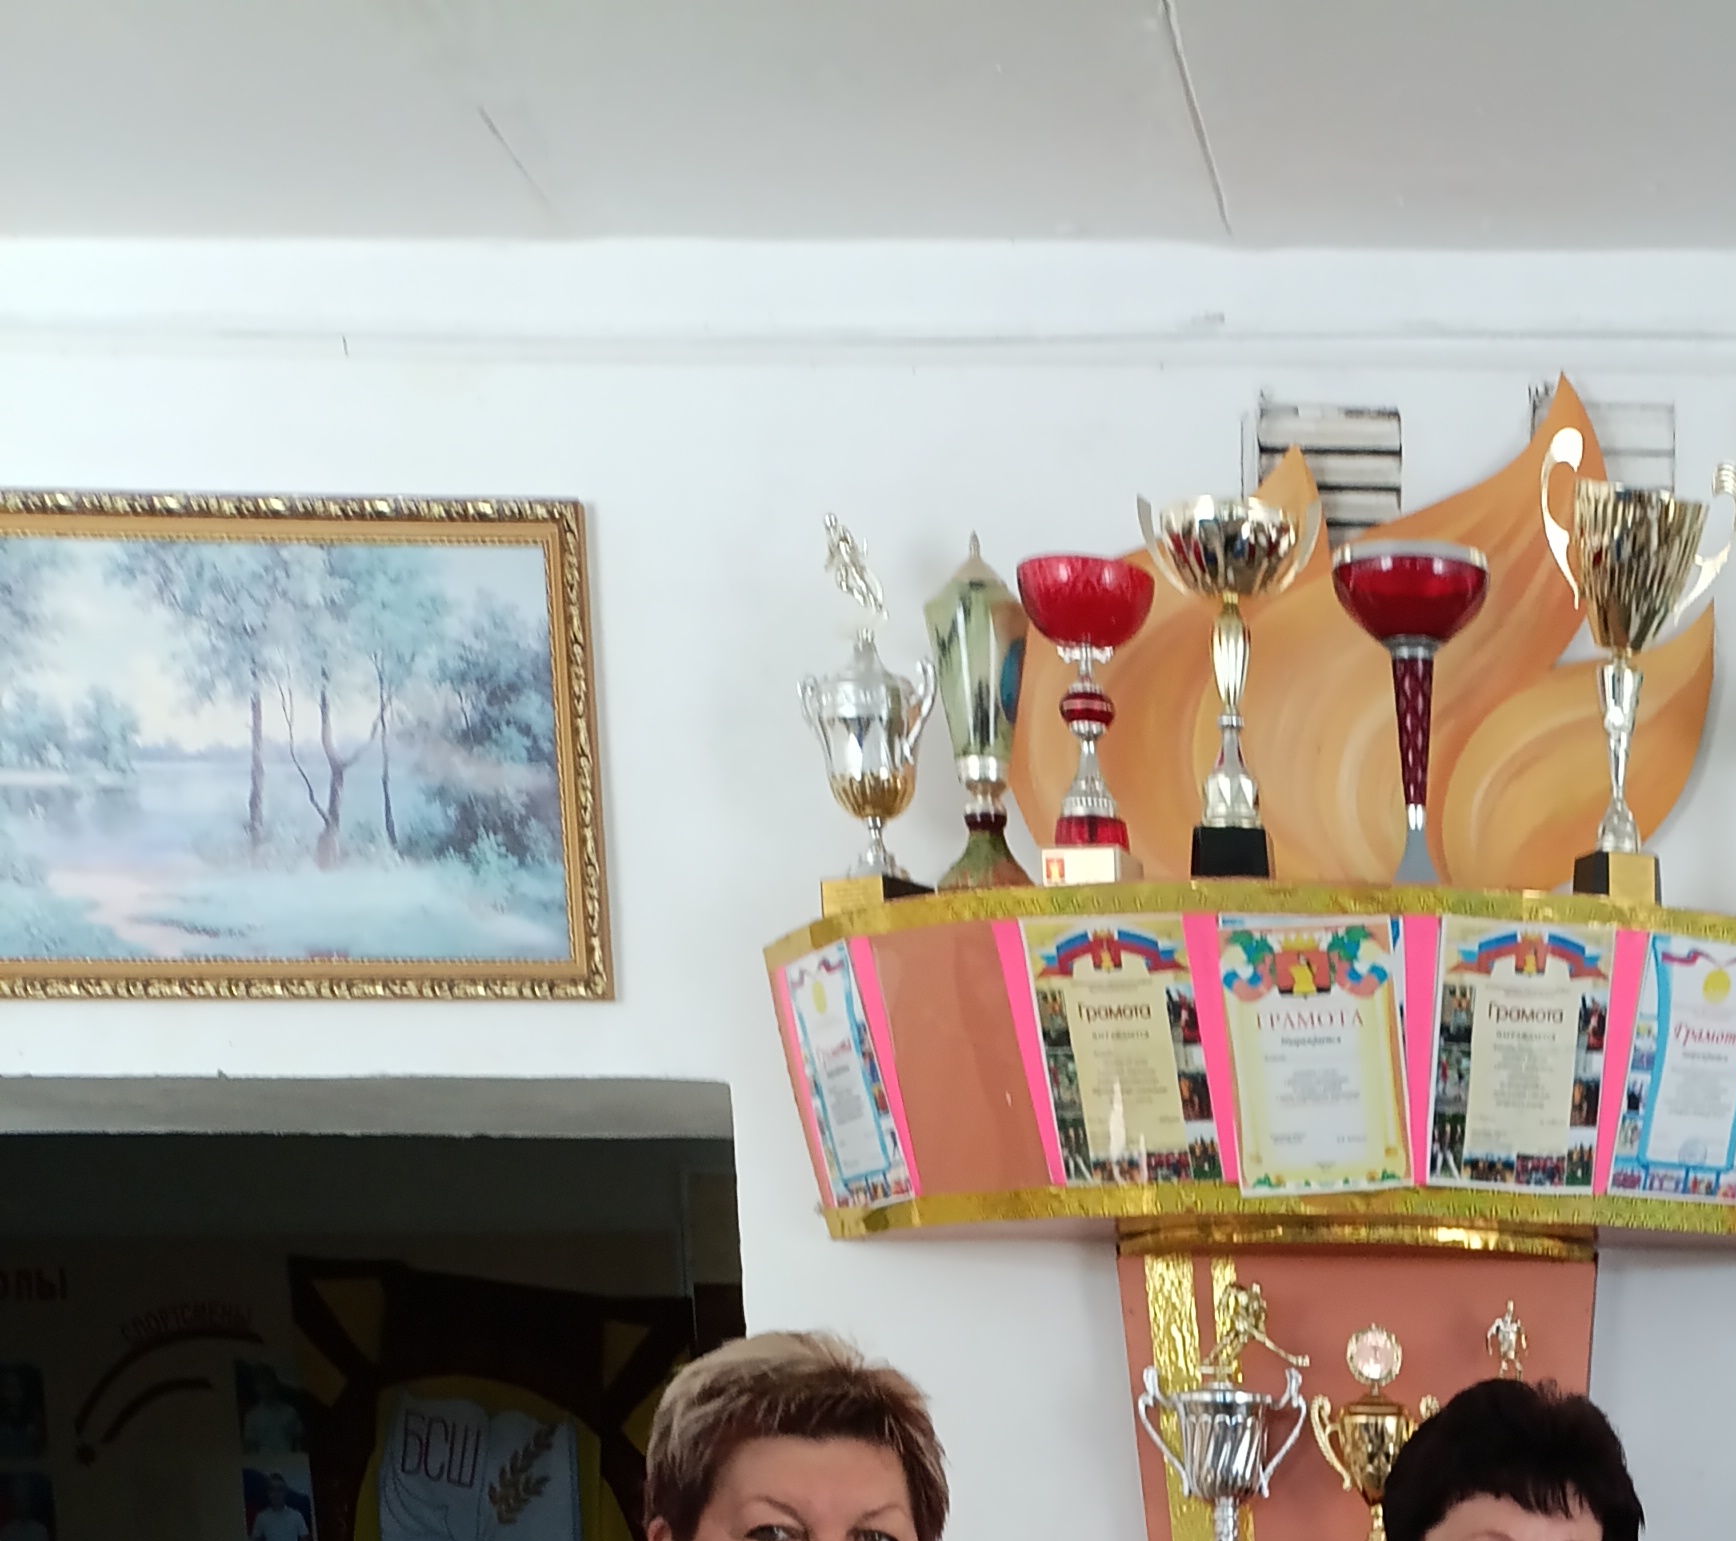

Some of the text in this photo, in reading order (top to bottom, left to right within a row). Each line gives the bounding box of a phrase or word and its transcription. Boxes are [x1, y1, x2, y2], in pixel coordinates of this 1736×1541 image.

[1078, 1001, 1151, 1023] Грамота
[1255, 1008, 1364, 1031] ГРАМОТА
[1488, 1001, 1563, 1025] Грамота
[401, 1408, 482, 1489] БСШ
